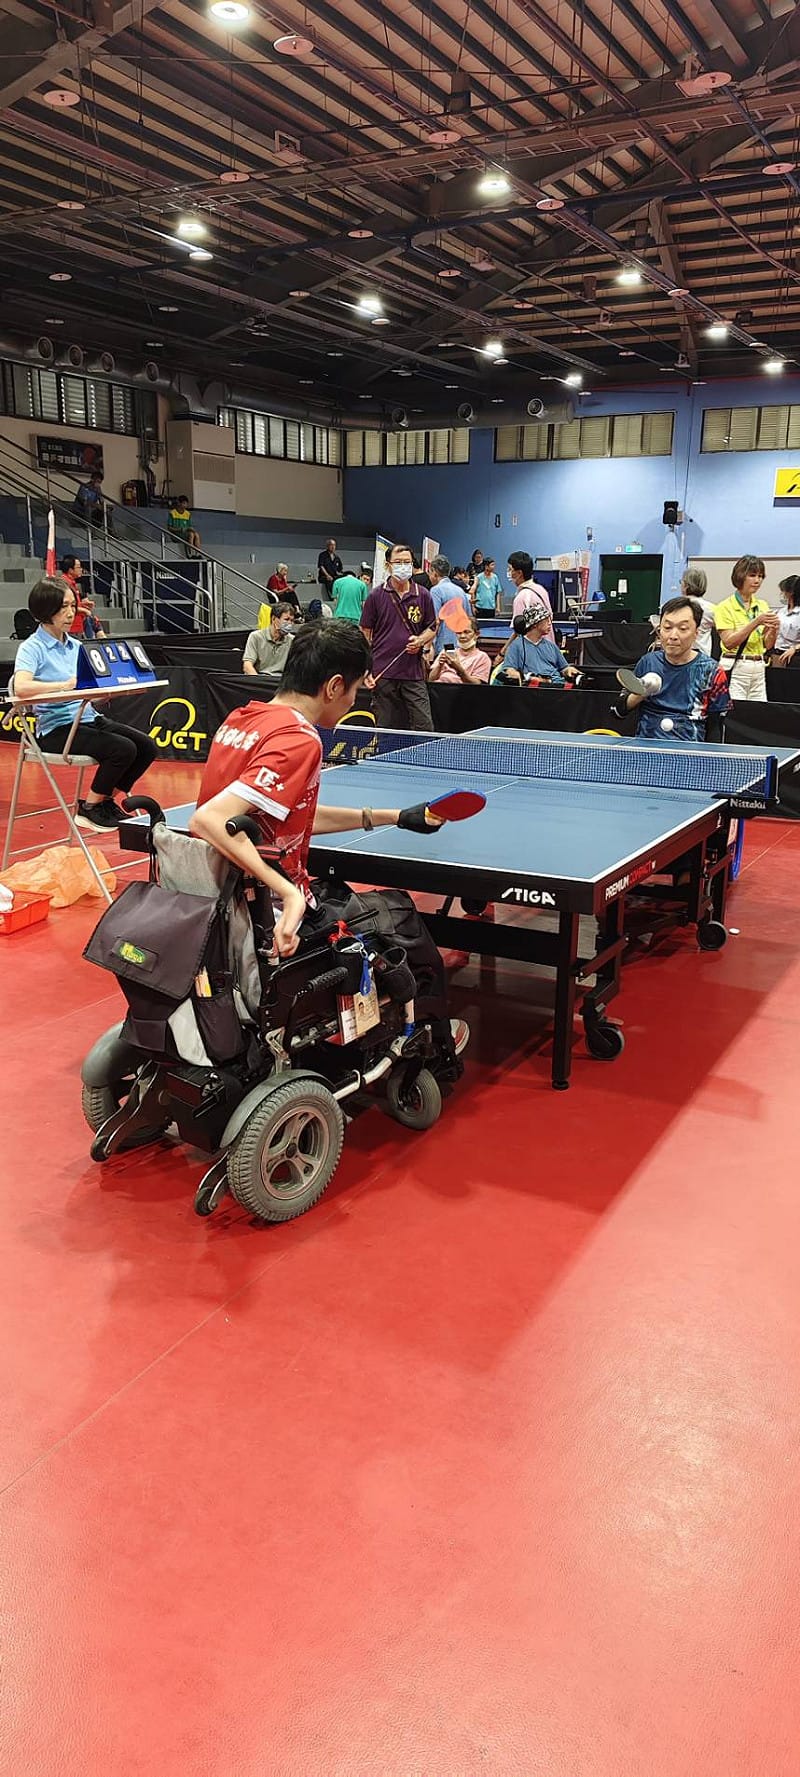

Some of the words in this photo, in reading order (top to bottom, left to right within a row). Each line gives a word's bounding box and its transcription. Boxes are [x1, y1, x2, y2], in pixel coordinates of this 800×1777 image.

[105, 646, 116, 660] 2
[730, 798, 766, 810] Nittaku
[501, 887, 556, 906] STIGA
